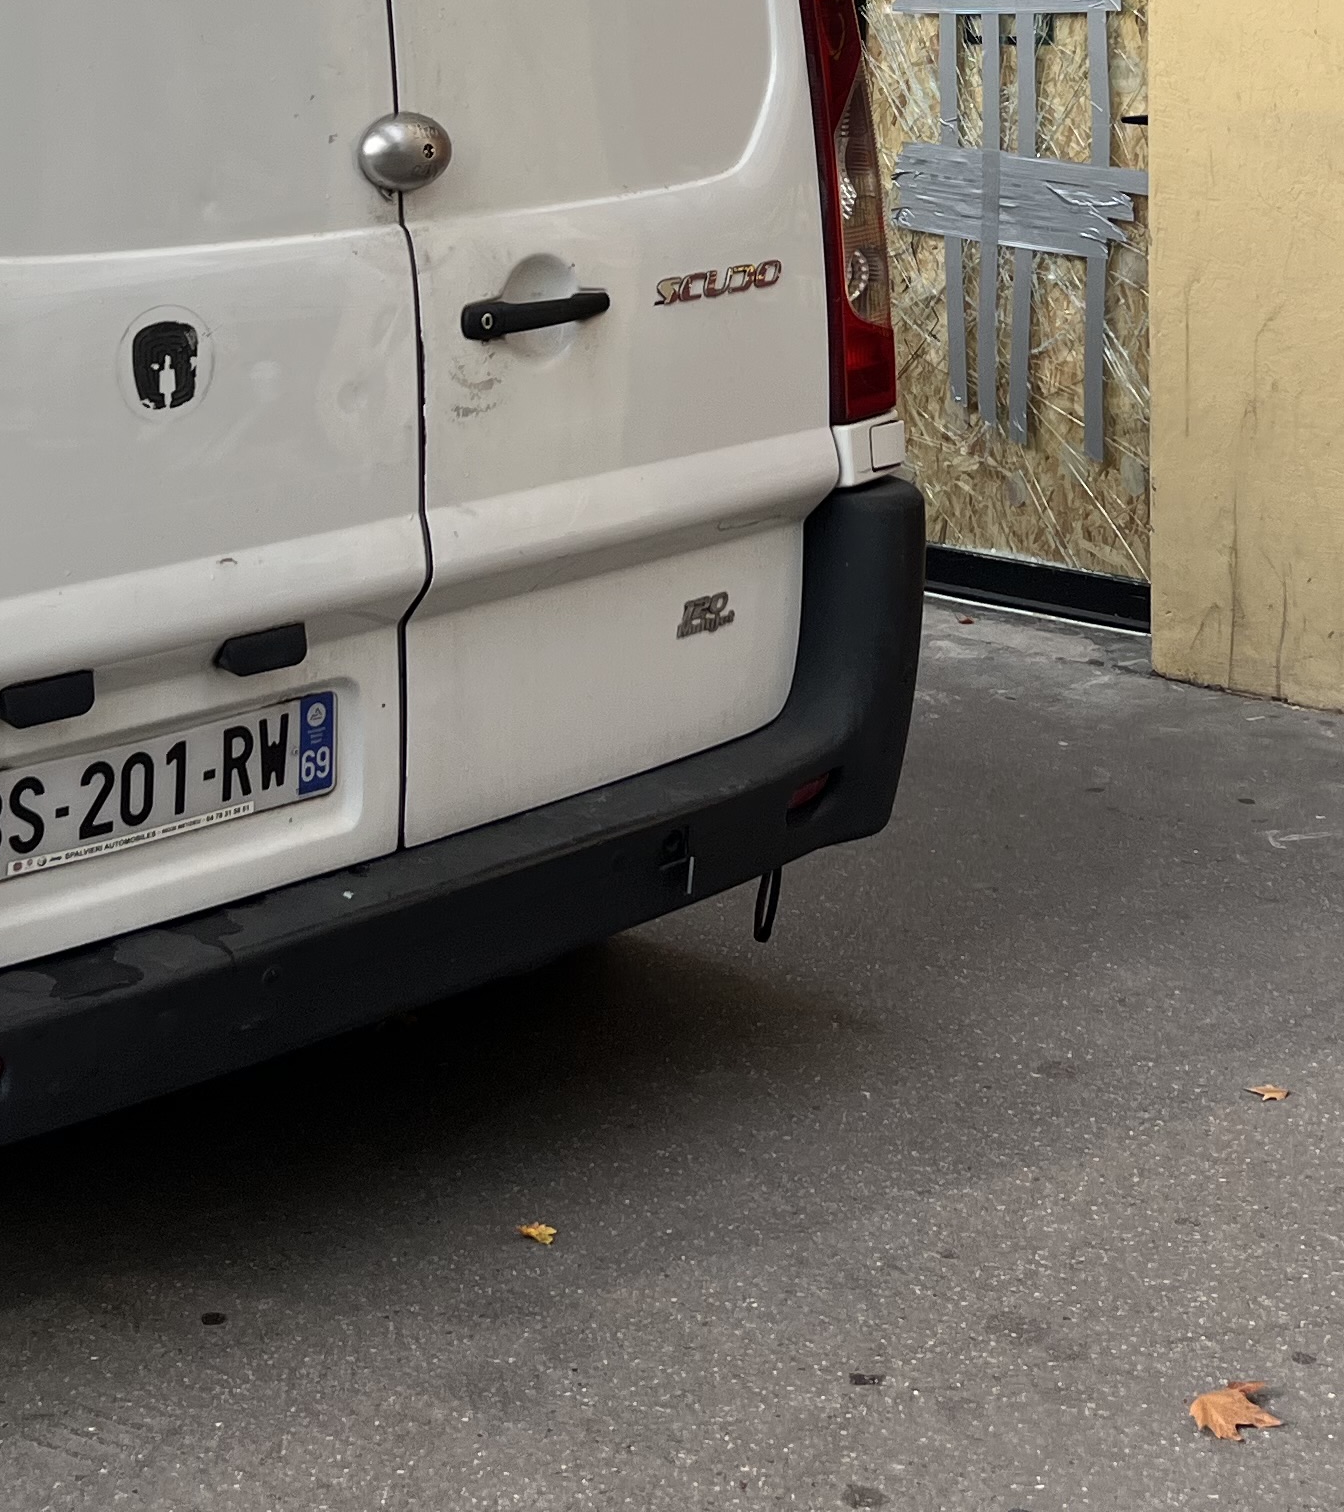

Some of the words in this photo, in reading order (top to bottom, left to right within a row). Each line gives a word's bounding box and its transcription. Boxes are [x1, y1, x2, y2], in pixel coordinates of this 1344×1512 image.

[654, 259, 782, 306] SCUDO
[300, 744, 331, 784] 69
[104, 830, 156, 851] AUTOMOBILES
